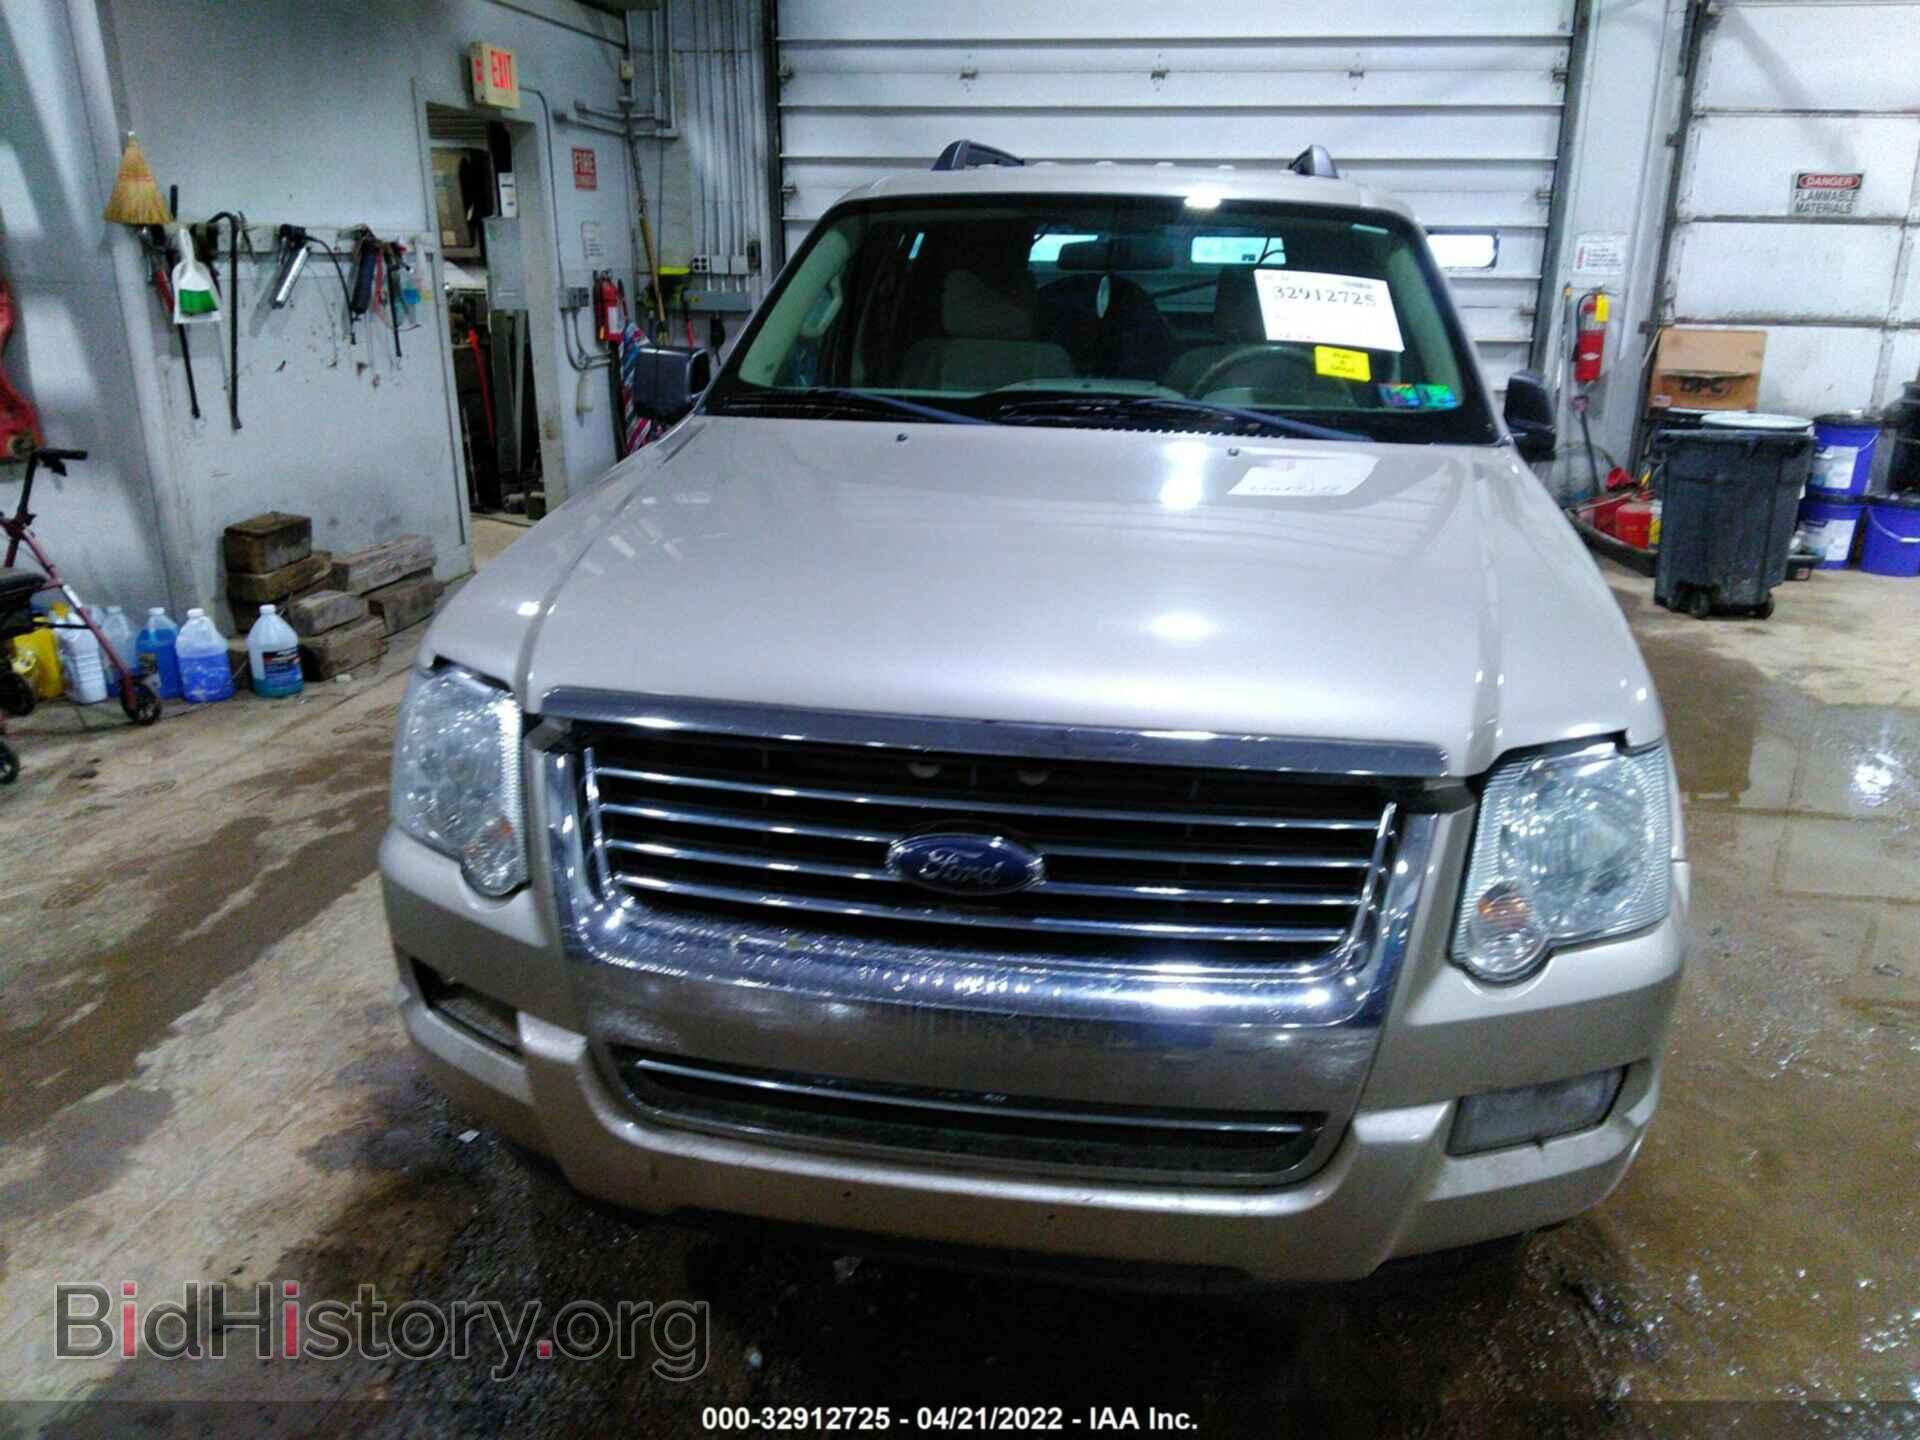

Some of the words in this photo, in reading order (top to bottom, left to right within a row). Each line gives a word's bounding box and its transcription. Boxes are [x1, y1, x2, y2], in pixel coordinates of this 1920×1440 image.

[491, 51, 513, 89] EXIT
[1806, 175, 1854, 188] DANGER
[1794, 190, 1858, 202] FLAMMABLE
[1795, 202, 1853, 214] MATERIALS
[1273, 286, 1377, 307] 32912725
[918, 848, 1005, 885] Ford
